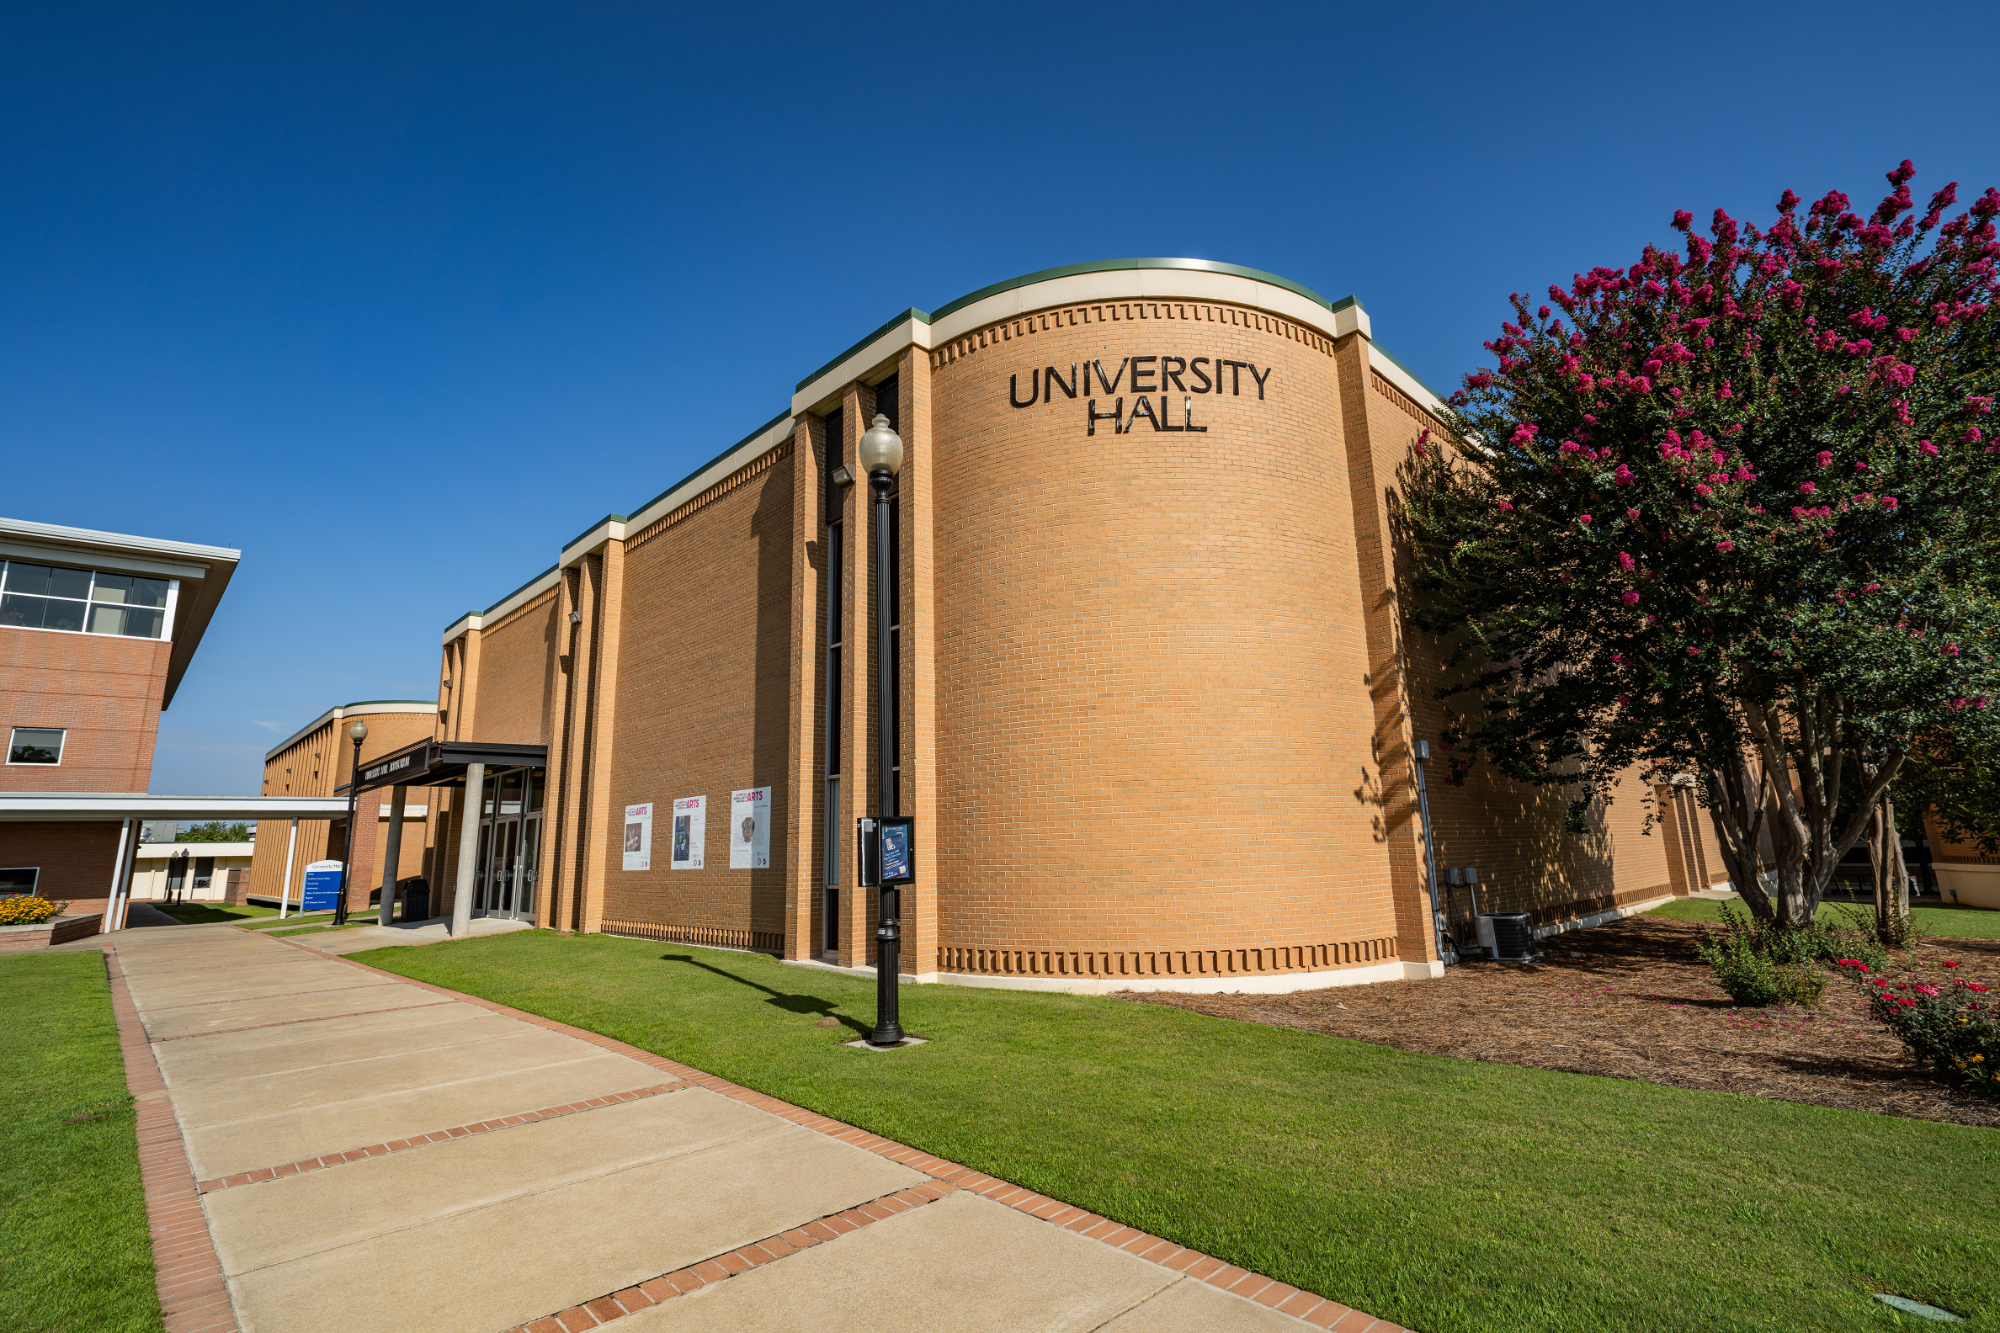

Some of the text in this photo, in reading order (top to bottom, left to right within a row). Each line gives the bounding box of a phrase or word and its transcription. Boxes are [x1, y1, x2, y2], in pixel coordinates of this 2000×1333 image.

[1009, 355, 1271, 409] UNIVERSITY
[1087, 395, 1208, 437] HALL
[747, 790, 763, 802] ARTS
[686, 798, 700, 809] ARTS
[635, 806, 648, 816] ARTS
